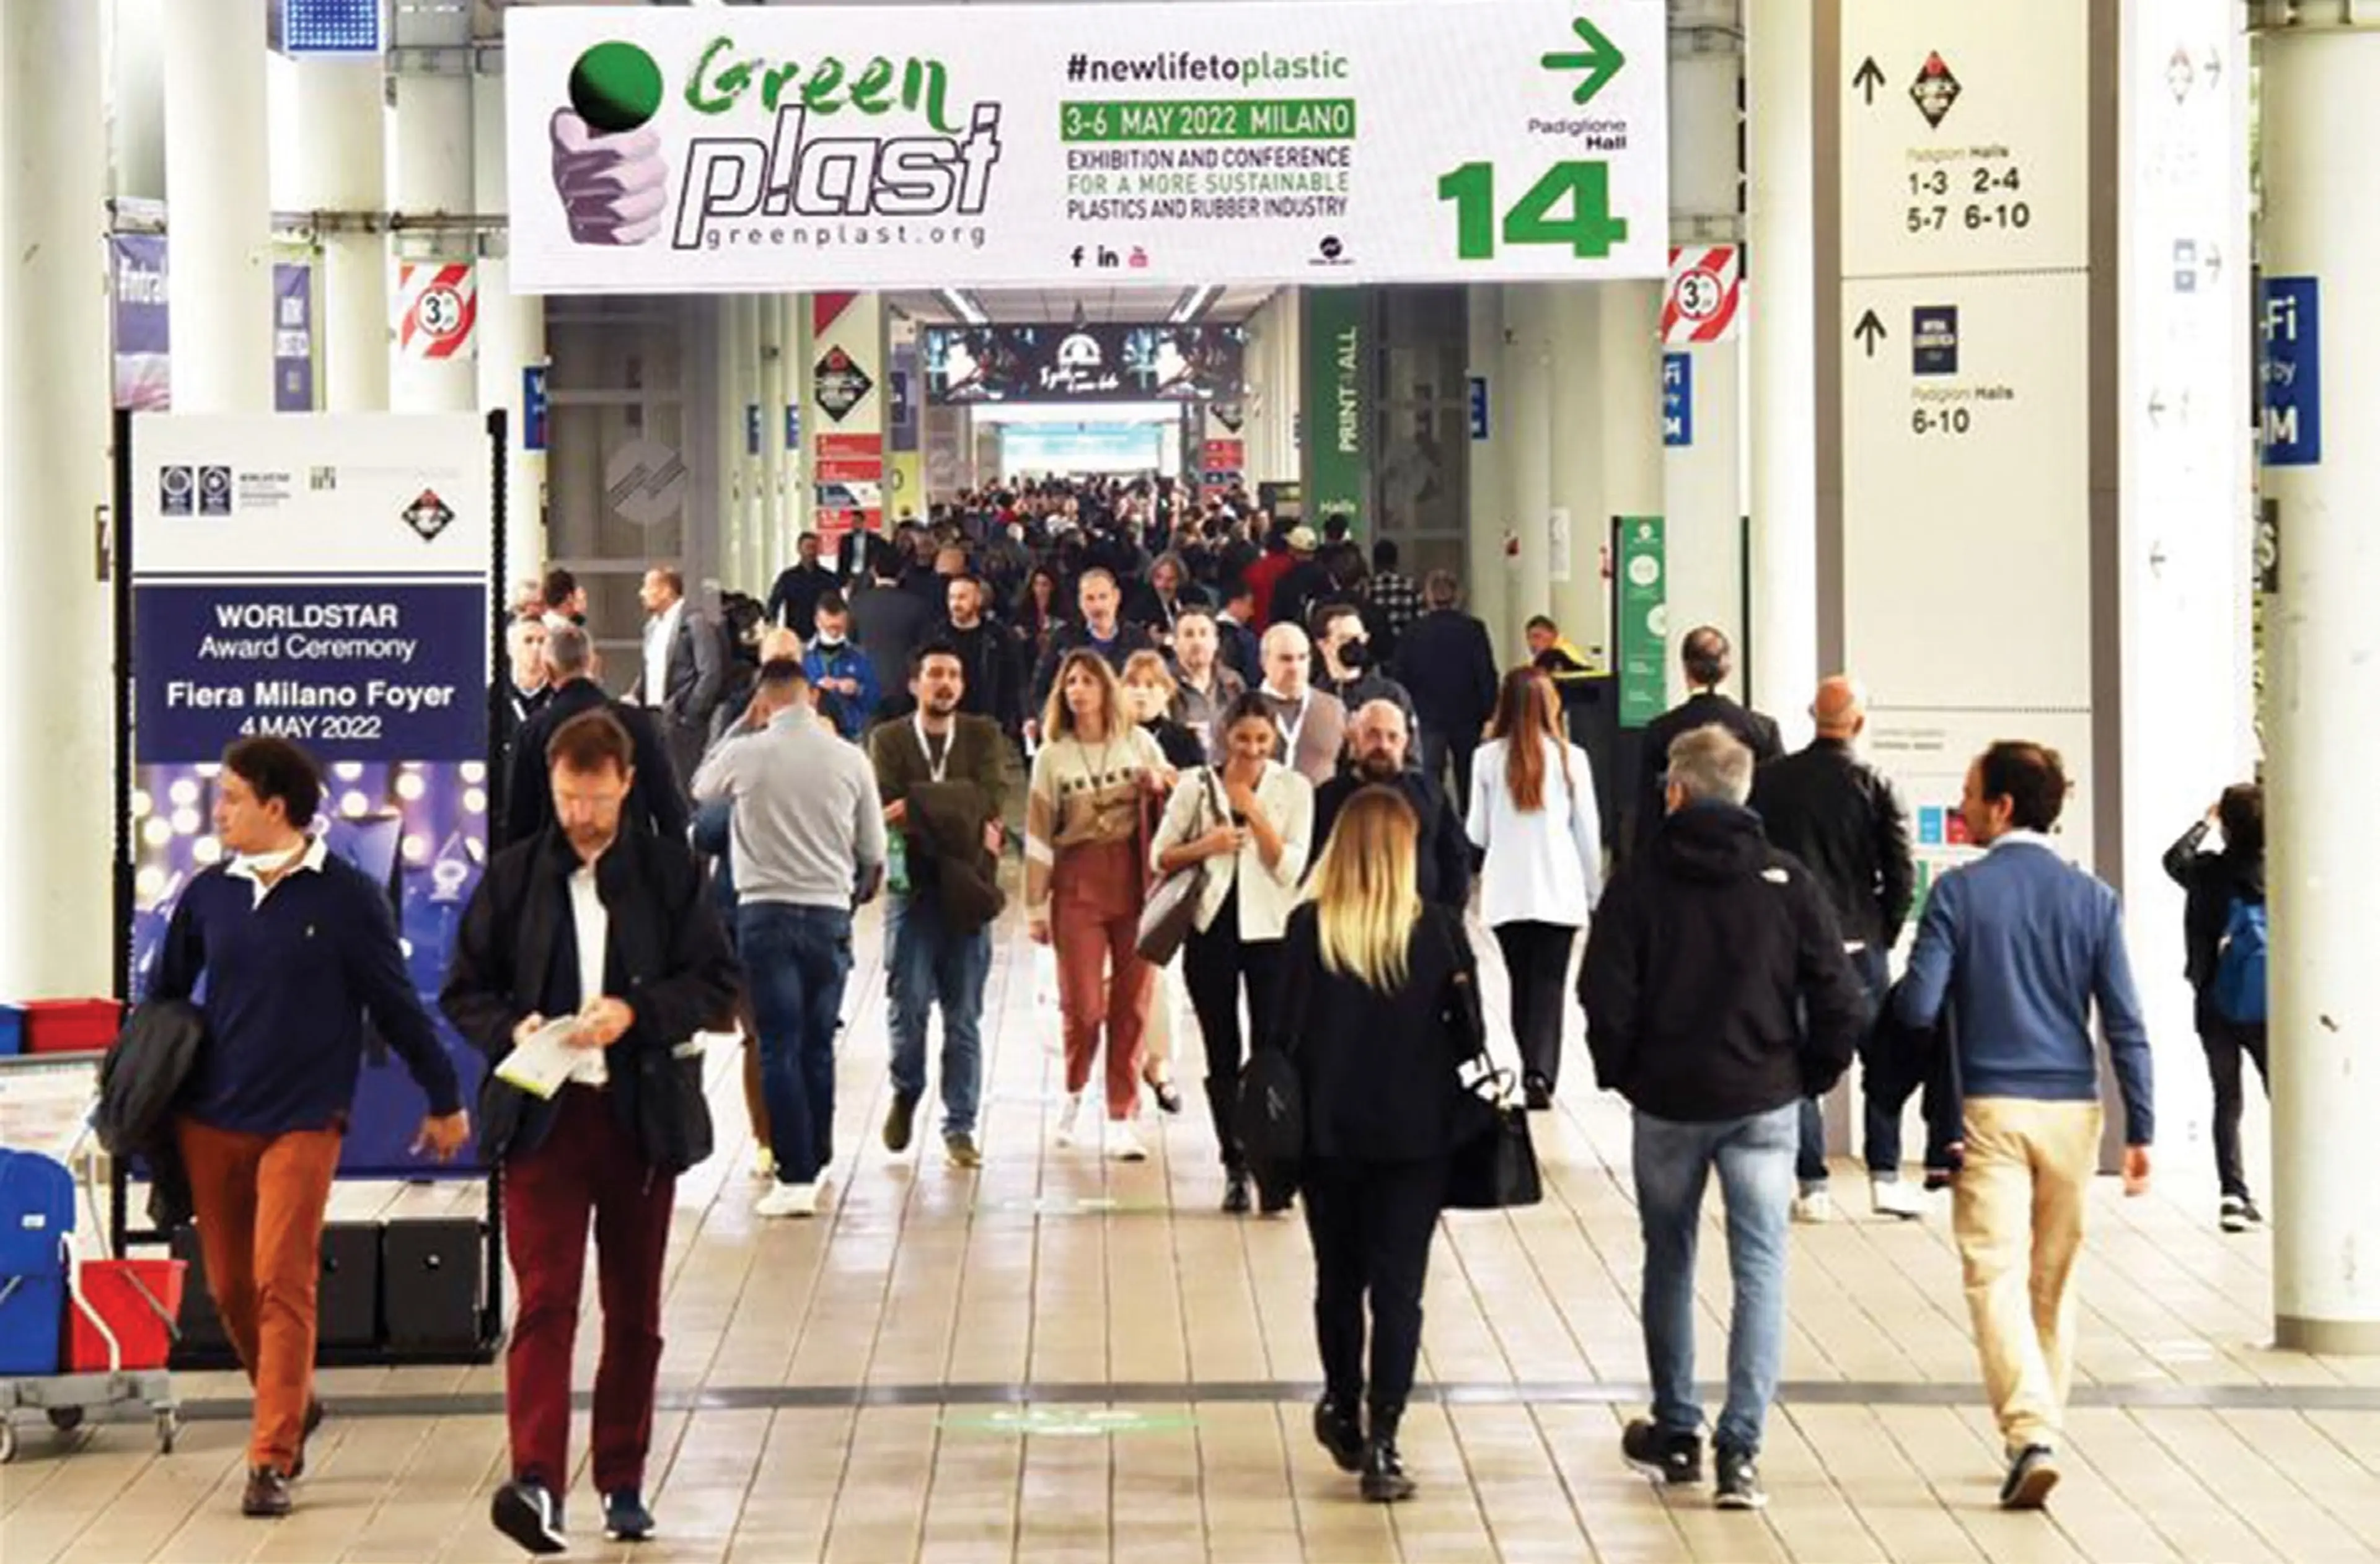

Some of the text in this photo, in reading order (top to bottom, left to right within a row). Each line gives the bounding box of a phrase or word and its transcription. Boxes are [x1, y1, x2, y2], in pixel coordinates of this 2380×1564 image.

[1068, 51, 1348, 86] #newlifetoplastic
[685, 37, 963, 134] Green
[1067, 105, 1349, 136] 3-6 MAY 2022 MILANO
[1586, 134, 1627, 150] Hall
[1067, 146, 1351, 170] EXHIBITION AND CONFERENCE
[1068, 171, 1349, 195] FOR A MORE SUSTAINABLE
[1908, 167, 2020, 196] 1-3 2-4
[1068, 196, 1347, 221] PLASTICS AND RUBBER INDUSTRY
[1438, 160, 1628, 259] 14
[1907, 201, 2030, 233] 5-7 6-10
[707, 225, 986, 246] greenplast.org
[1912, 406, 1970, 434] 6-10
[215, 604, 399, 628] WORLDSTAR
[197, 635, 417, 663] Award Ceremony
[167, 681, 456, 713] Fiera Milano Foyer
[239, 716, 382, 738] 4 MAY 2022
